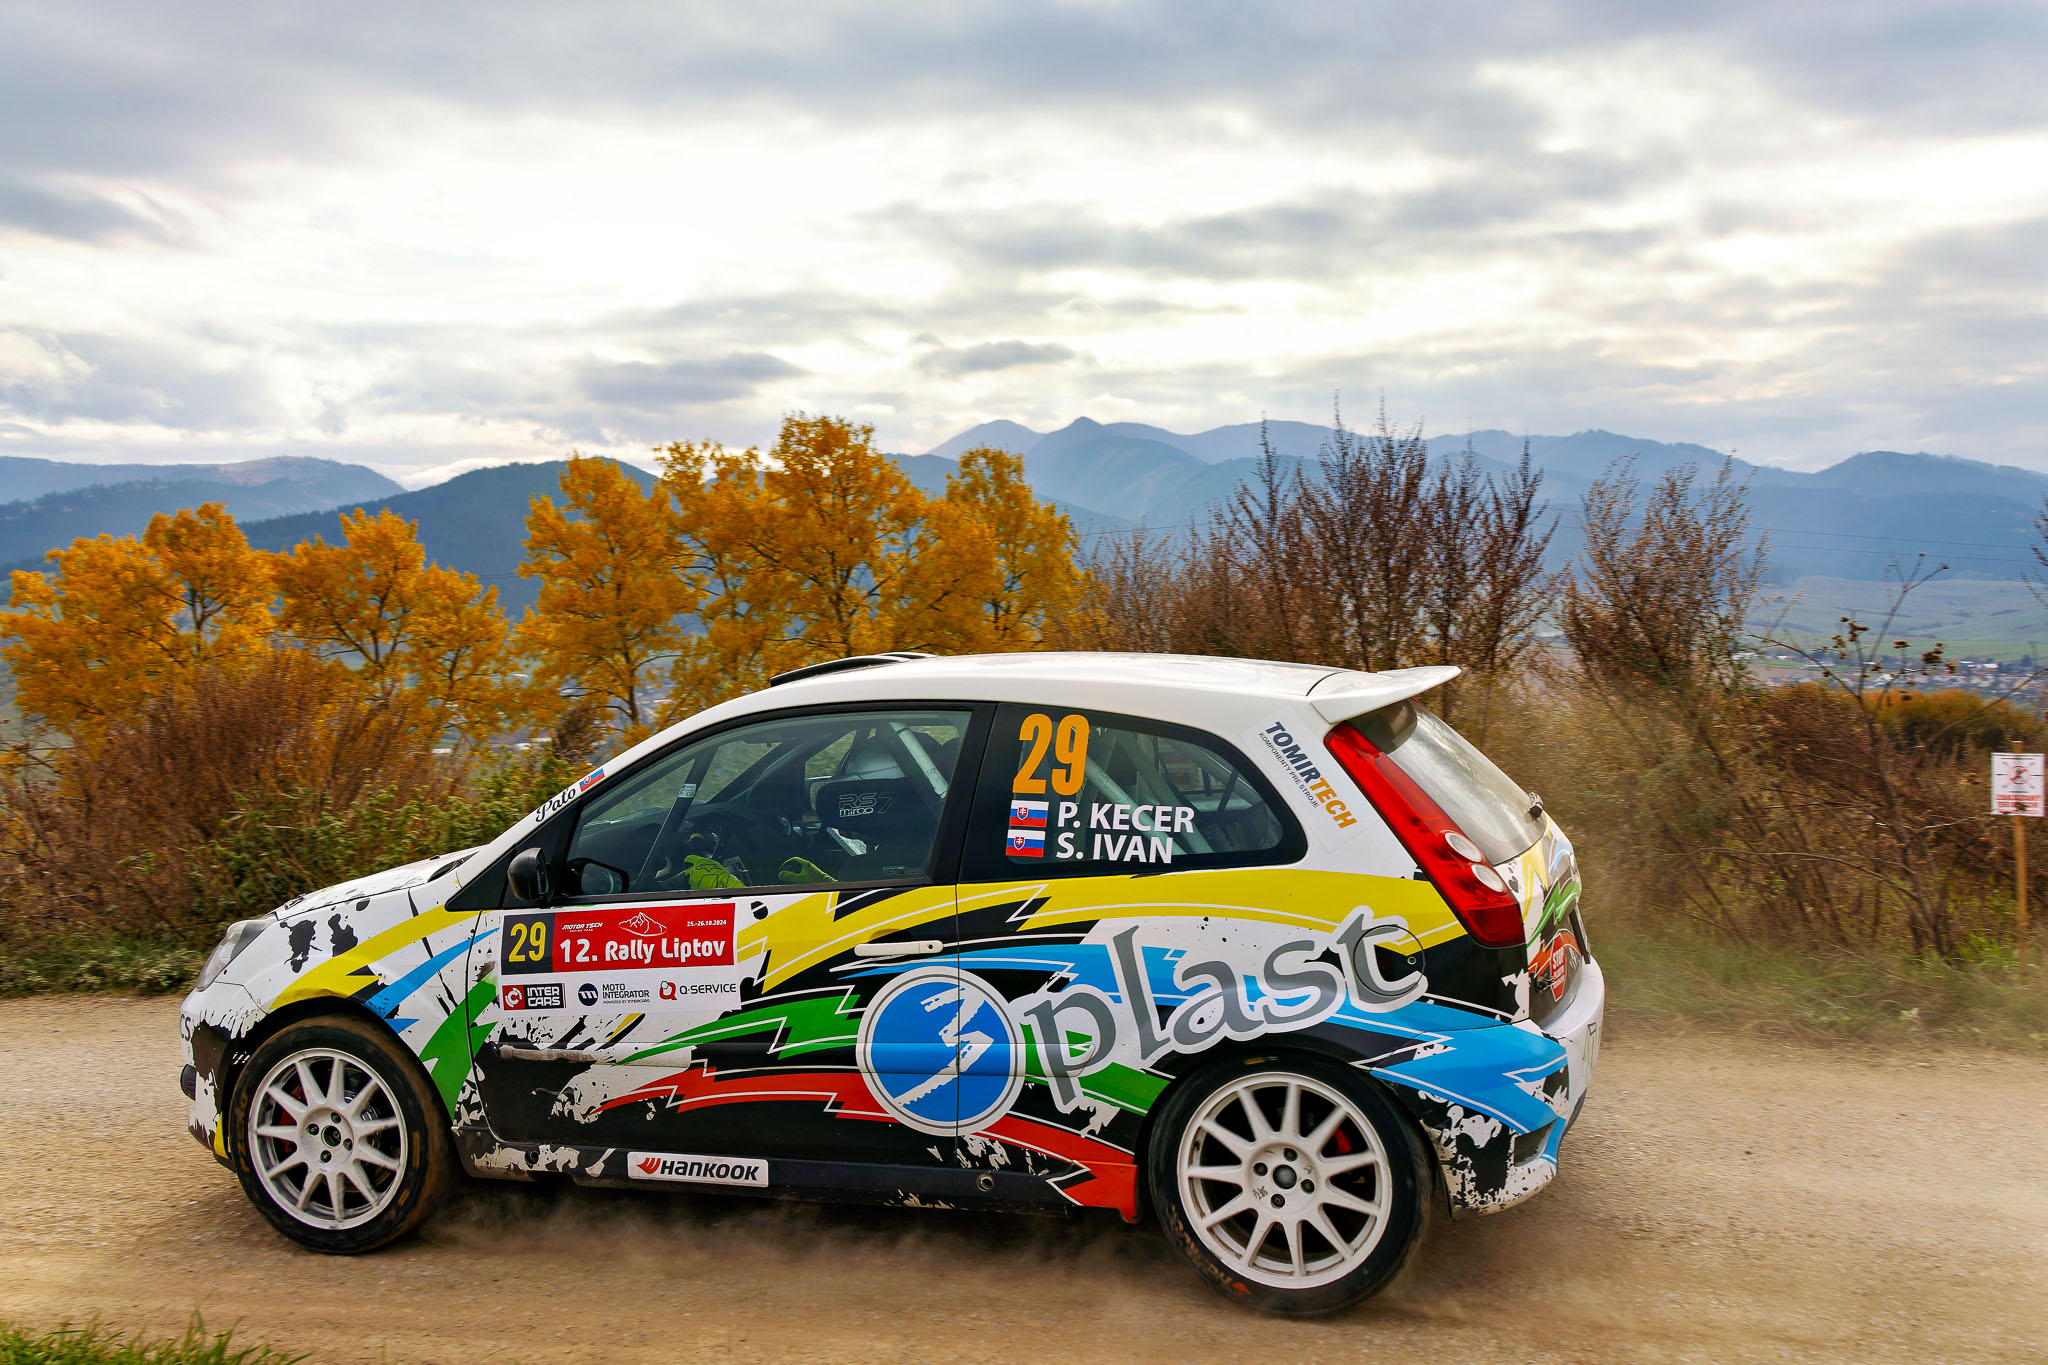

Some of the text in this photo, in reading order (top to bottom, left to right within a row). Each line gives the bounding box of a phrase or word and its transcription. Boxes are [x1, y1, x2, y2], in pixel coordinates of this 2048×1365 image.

[1012, 713, 1090, 796] 29
[1265, 721, 1358, 829] TOMIRTECH
[1057, 801, 1195, 833] P. KECER
[1056, 832, 1174, 865] S. IVAN
[561, 923, 586, 931] MOTOR
[508, 921, 547, 964] 29
[559, 937, 726, 965] 12. Rally Liptov
[526, 985, 560, 996] INTER
[527, 996, 561, 1007] CARS
[602, 983, 626, 991] MOTO
[602, 990, 650, 999] INTEGRATOR
[1024, 912, 1425, 1106] plast
